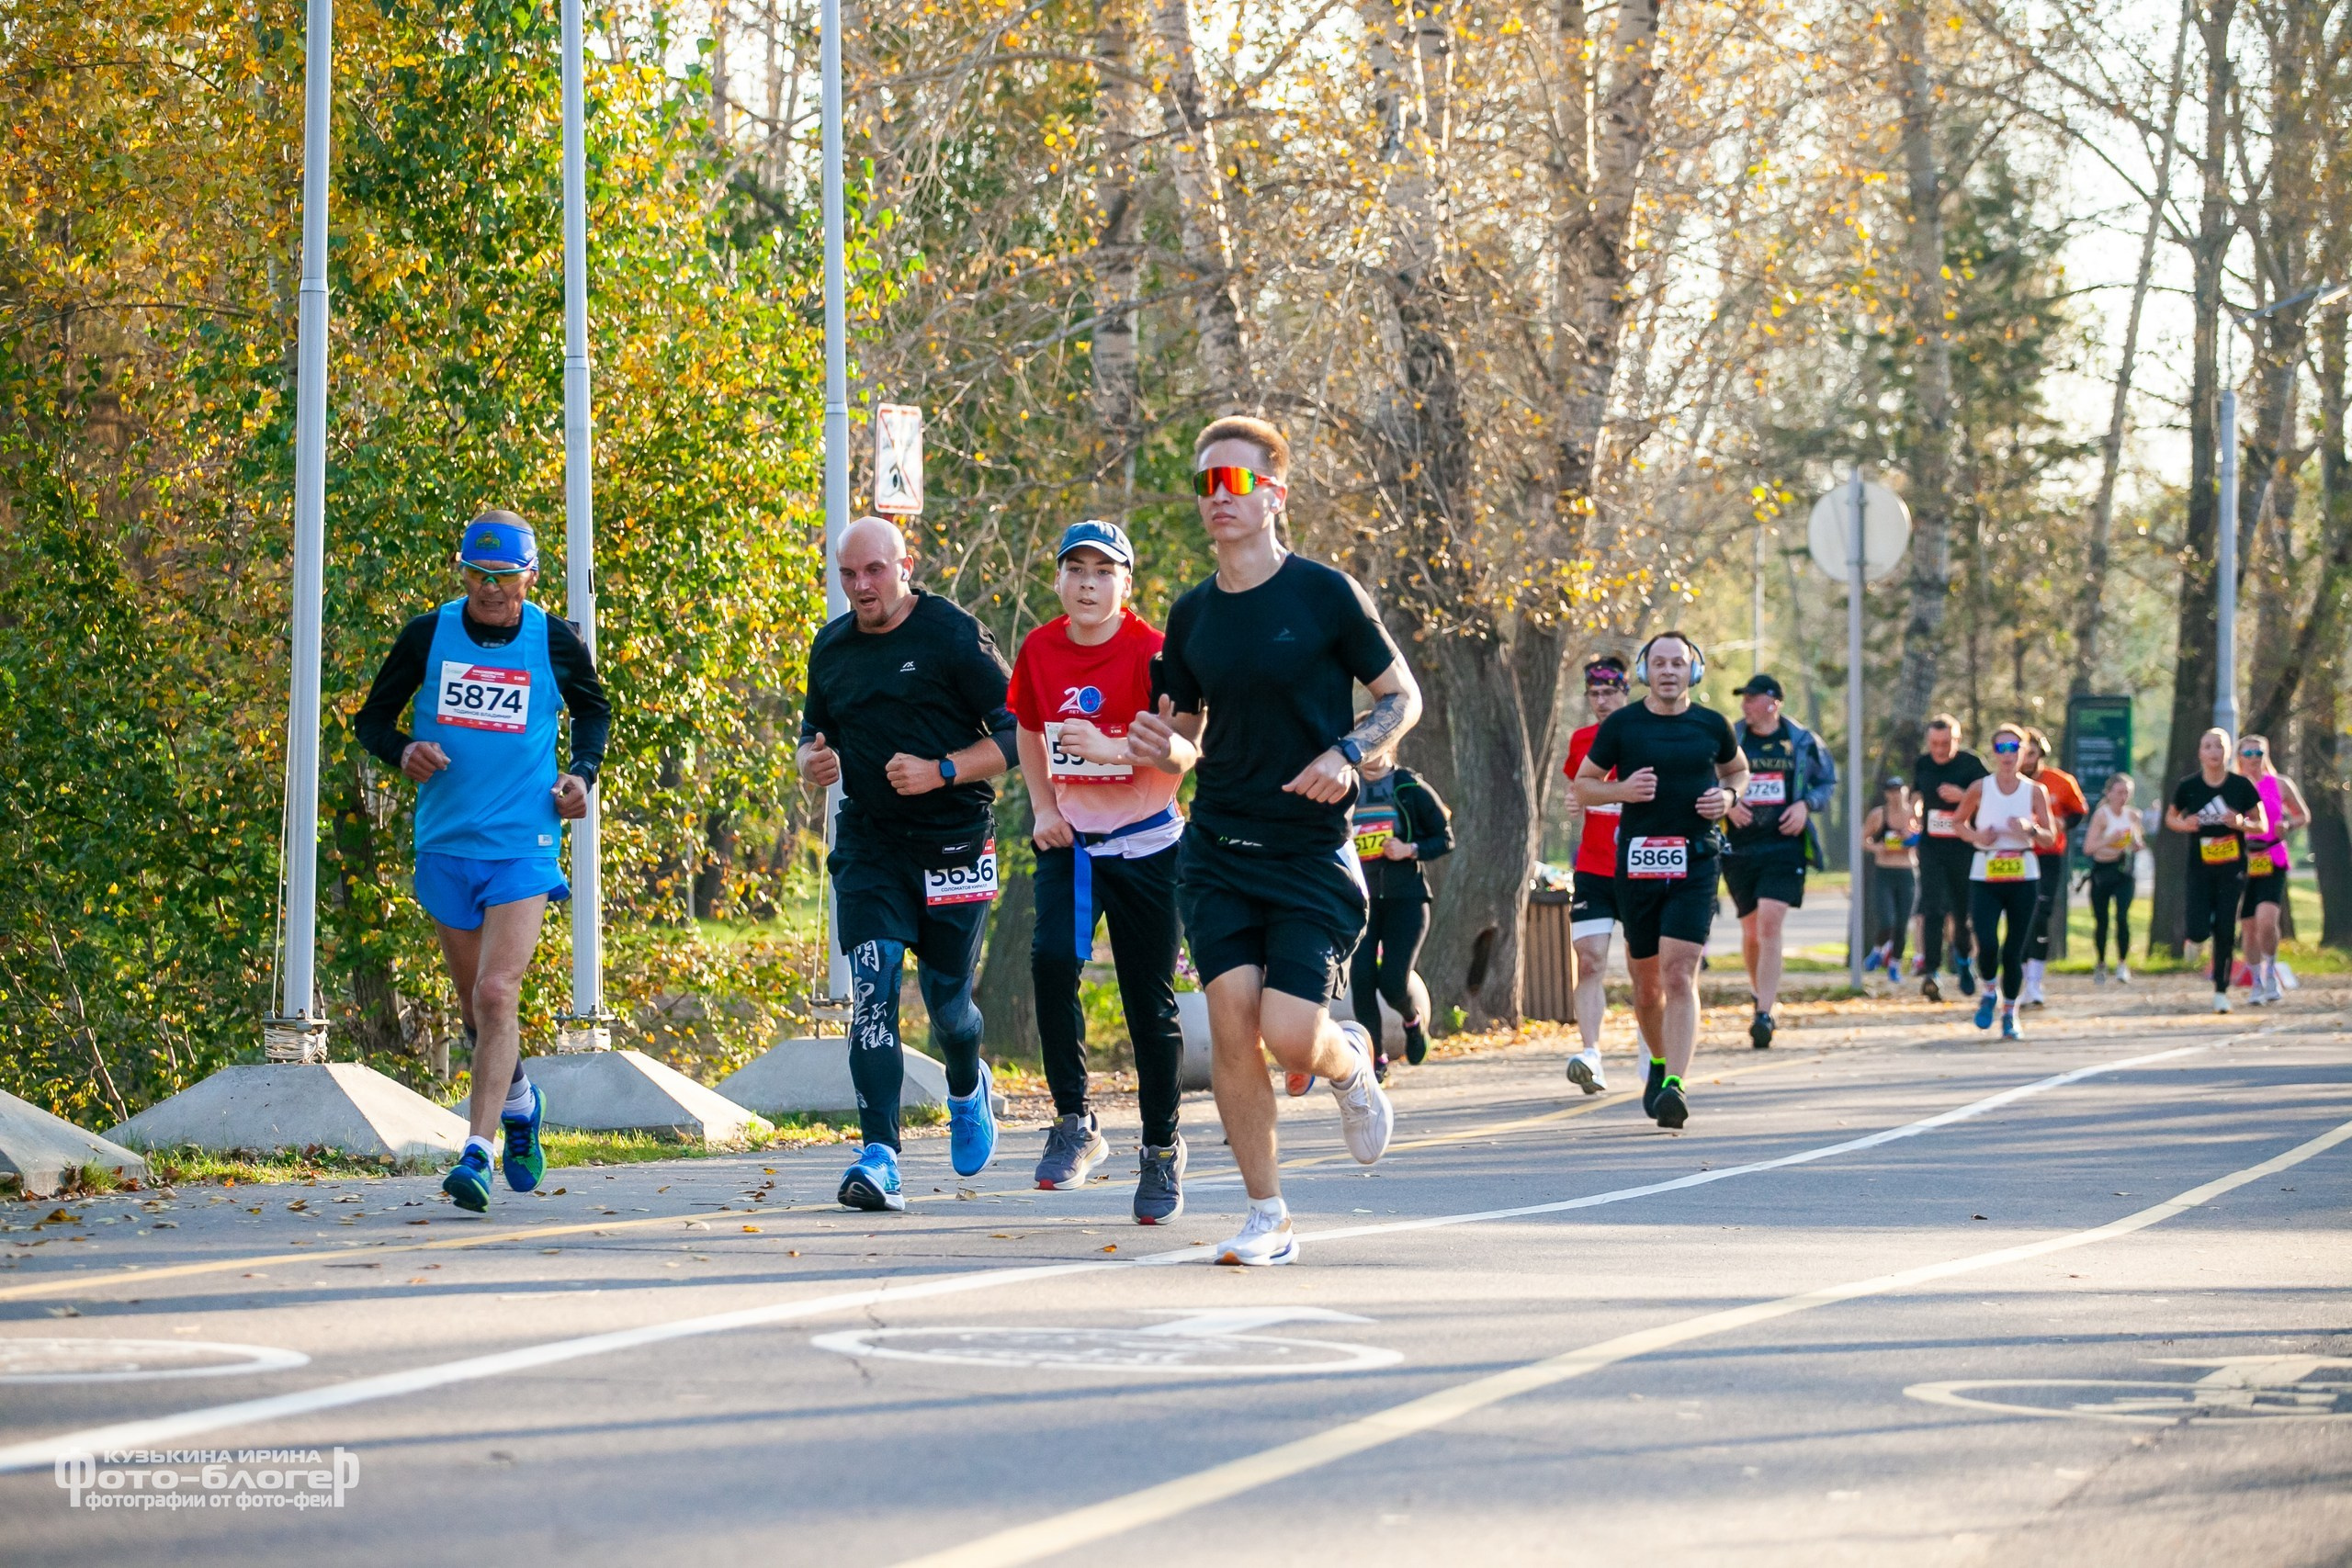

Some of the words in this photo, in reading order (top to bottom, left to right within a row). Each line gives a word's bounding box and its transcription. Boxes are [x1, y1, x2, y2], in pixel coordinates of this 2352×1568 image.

[445, 682, 523, 714] 5874
[1057, 685, 1102, 714] 20
[1631, 850, 1683, 865] 5866
[931, 858, 994, 886] 5636
